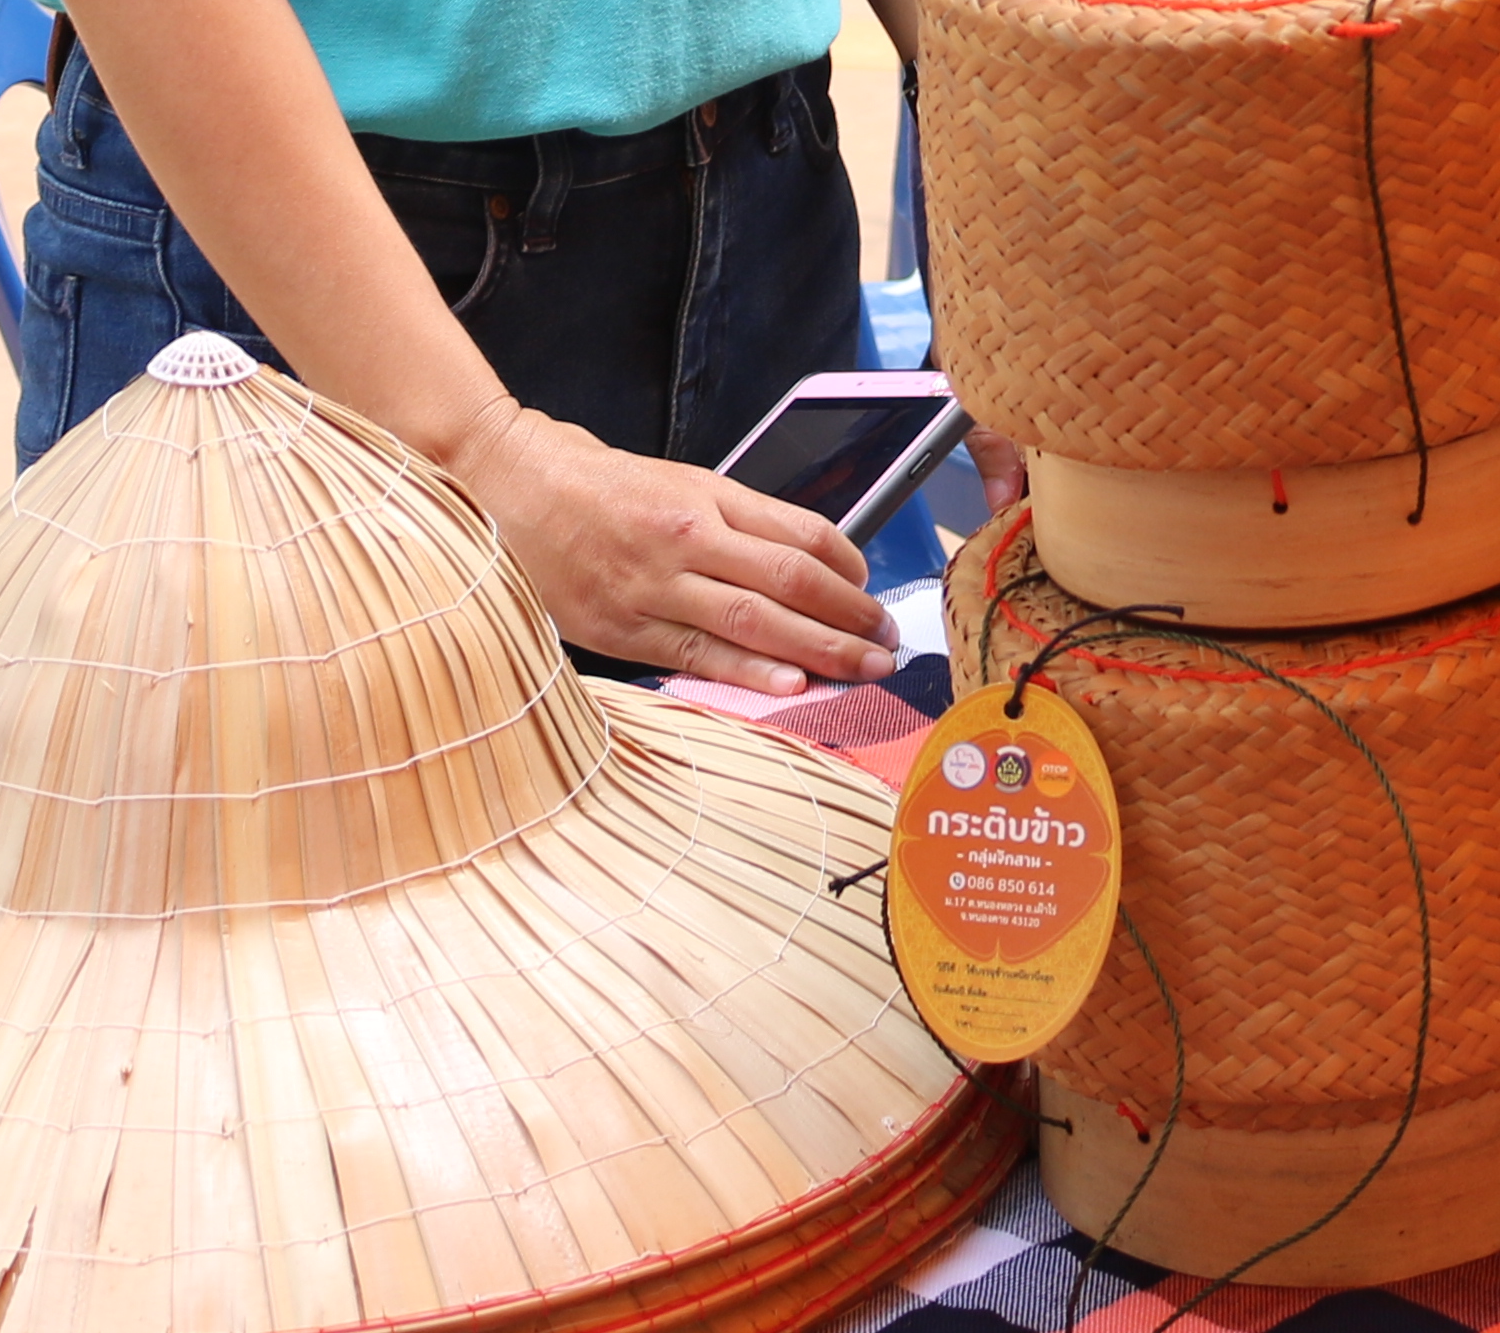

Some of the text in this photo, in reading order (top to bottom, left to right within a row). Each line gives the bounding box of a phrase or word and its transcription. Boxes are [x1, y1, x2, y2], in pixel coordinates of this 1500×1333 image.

[928, 805, 1086, 848] กระติบข้าว
[967, 875, 1055, 896] 086 850 614
